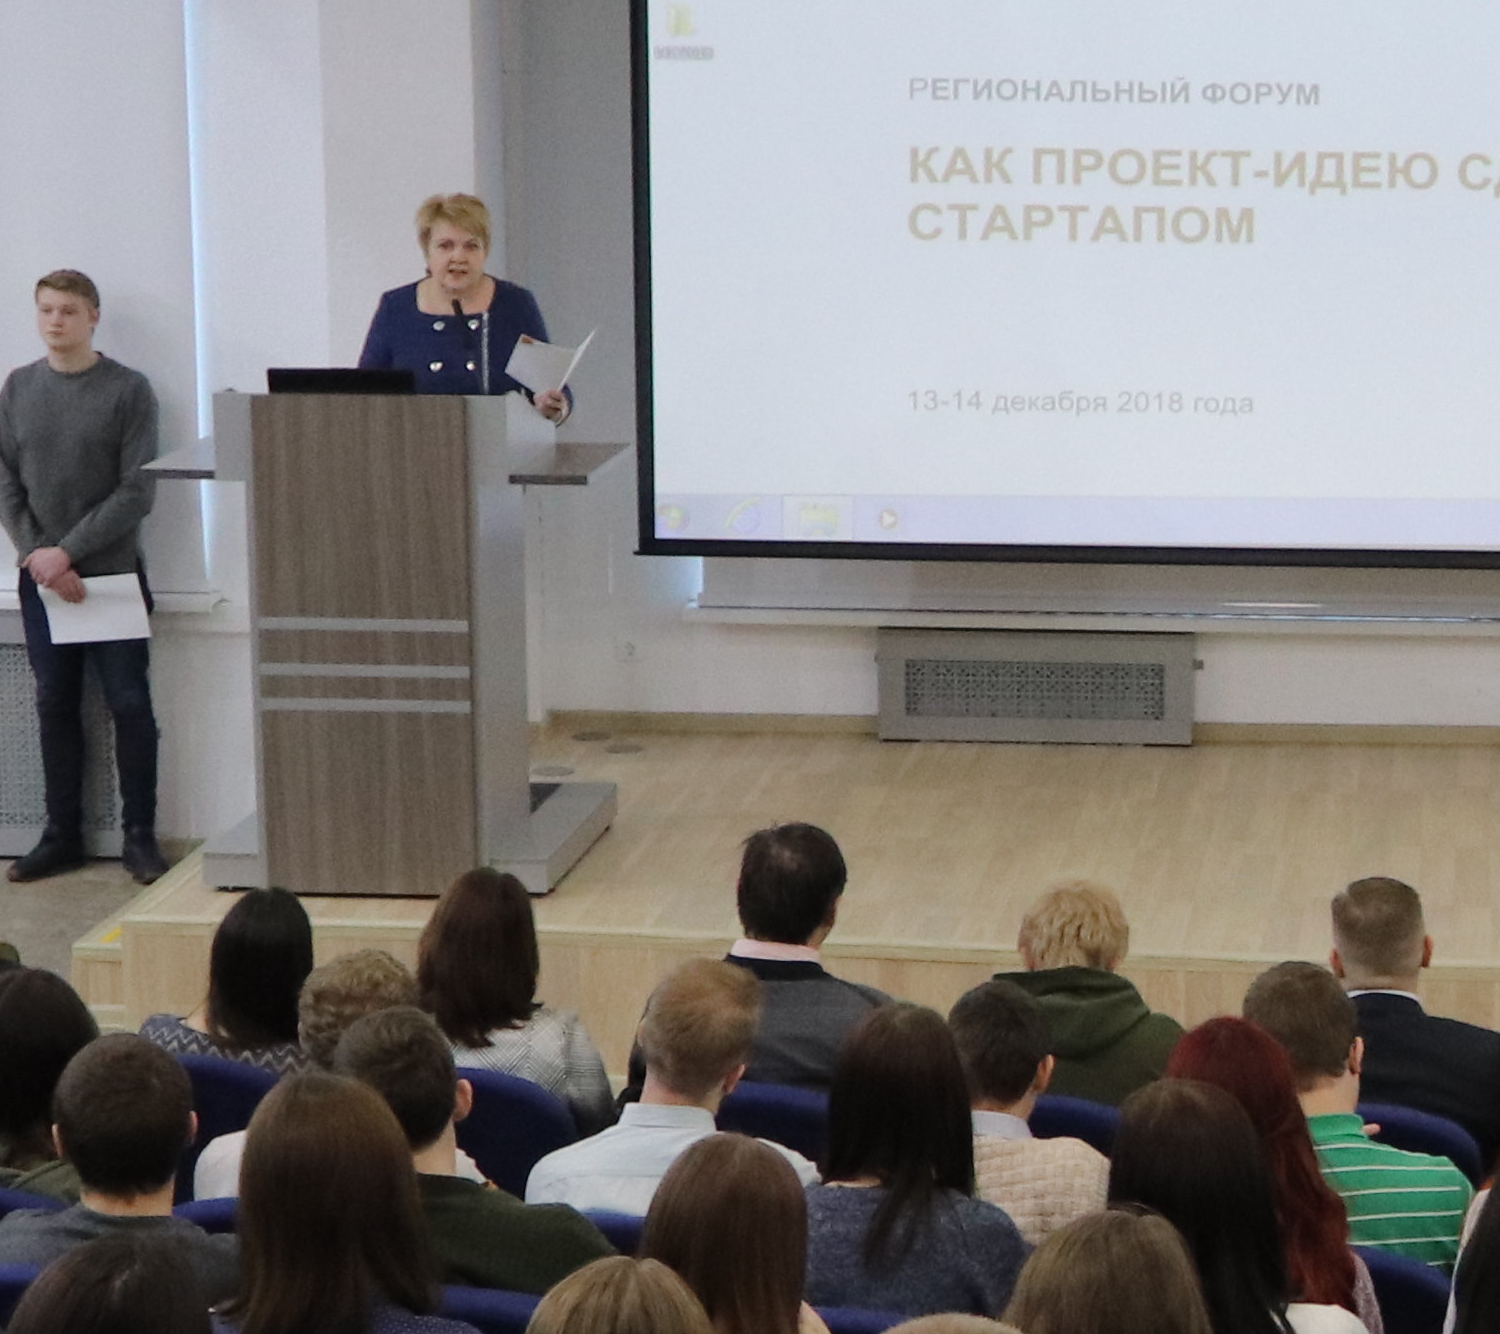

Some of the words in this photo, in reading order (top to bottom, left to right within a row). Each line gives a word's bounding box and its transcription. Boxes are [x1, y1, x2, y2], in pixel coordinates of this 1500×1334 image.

[908, 76, 1190, 104] РЕГИОНАЛЬНЫЙ
[1201, 82, 1321, 105] ФОРУМ
[908, 146, 1013, 186] КАК
[1032, 148, 1439, 196] ПРОЕКТ-ИДЕЮ
[908, 203, 1257, 244] СТАРТАПОМ
[907, 390, 982, 412] 13-14
[991, 390, 1109, 417] декабря
[1117, 391, 1184, 413] 2018
[1193, 395, 1255, 416] года
